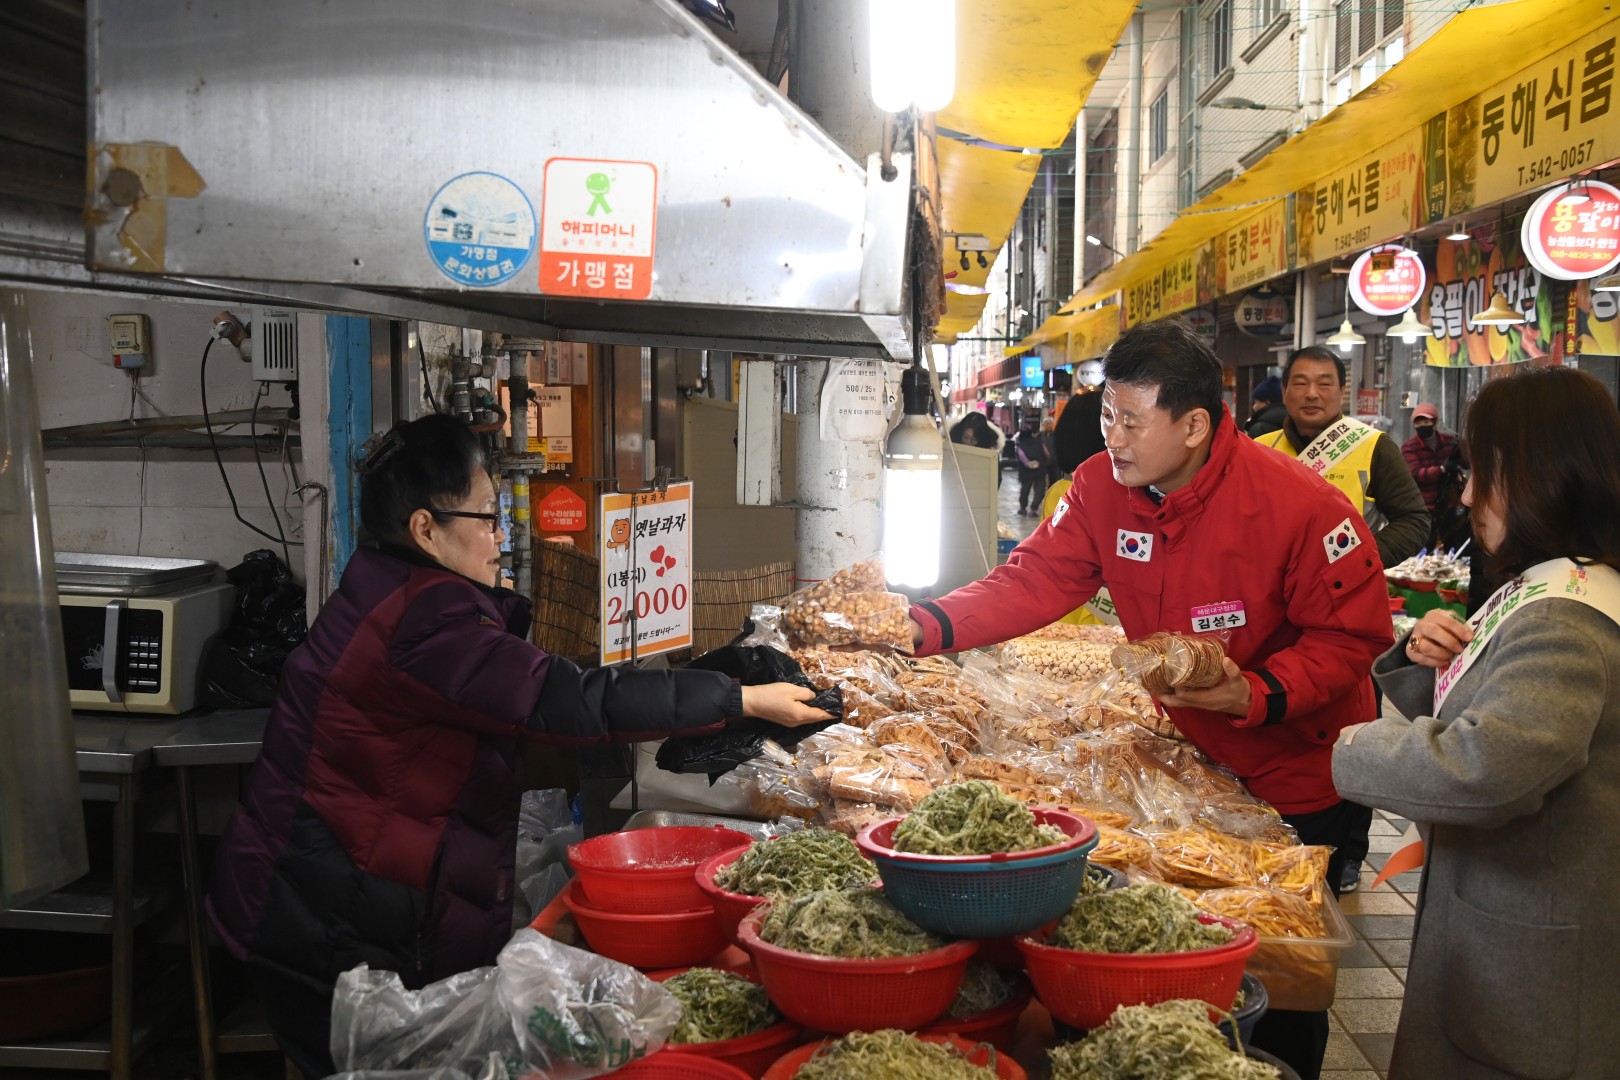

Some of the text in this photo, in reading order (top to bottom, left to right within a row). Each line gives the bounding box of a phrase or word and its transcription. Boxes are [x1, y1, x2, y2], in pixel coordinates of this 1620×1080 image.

[1481, 36, 1616, 167] 동해식품
[1517, 138, 1594, 186] T.542-0057
[1316, 159, 1380, 235] 동해식품
[561, 220, 635, 239] 해피머니
[1334, 226, 1371, 251] T.542-0057
[460, 245, 498, 261] 가맹점
[1228, 216, 1273, 272] 동경분식
[444, 256, 515, 281] 문화상품권
[557, 260, 634, 289] 가맹점
[1243, 307, 1284, 321] 동경분식
[1306, 423, 1351, 460] 전통시장
[1325, 427, 1370, 461] 시장에서
[543, 510, 583, 518] 온누리상품권
[635, 513, 686, 539] 옛날과자
[607, 567, 646, 588] (1봉지)
[1197, 604, 1237, 615] 해운대구청장
[1198, 614, 1240, 629] 김성수
[1462, 576, 1525, 648] 전통시
[1470, 582, 1548, 656] 시장에서
